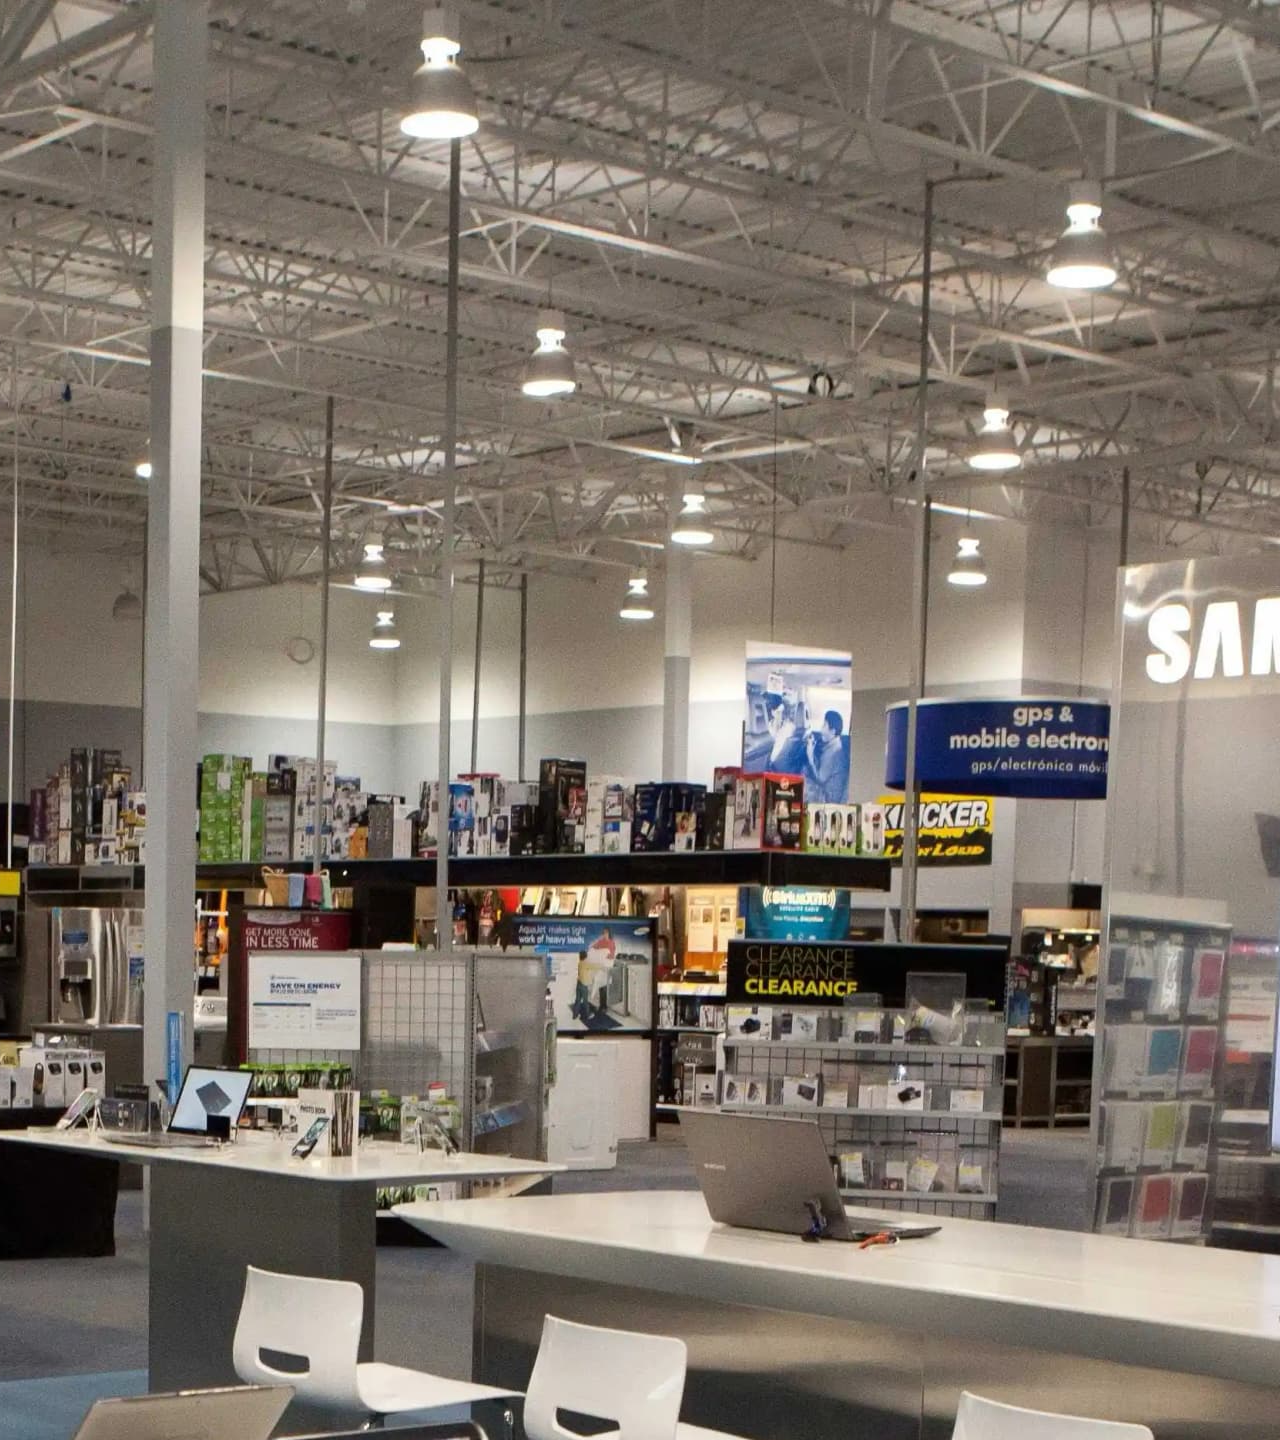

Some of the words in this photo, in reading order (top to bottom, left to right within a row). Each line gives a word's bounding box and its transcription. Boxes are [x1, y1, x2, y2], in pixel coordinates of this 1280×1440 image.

[1013, 706, 1054, 727] gps
[1059, 705, 1074, 722] &
[949, 727, 1020, 749] mobile
[245, 928, 262, 937] GET
[264, 928, 287, 937] MORE
[289, 928, 311, 937] DONE
[518, 935, 535, 944] work
[537, 935, 544, 944] of
[545, 935, 566, 945] heavy
[246, 937, 257, 948] IN
[261, 937, 289, 948] LESS
[293, 937, 319, 948] TIME
[746, 945, 855, 963] CLEARANCE
[746, 962, 855, 980] CLEARANCE
[745, 978, 858, 997] CLEARANCE
